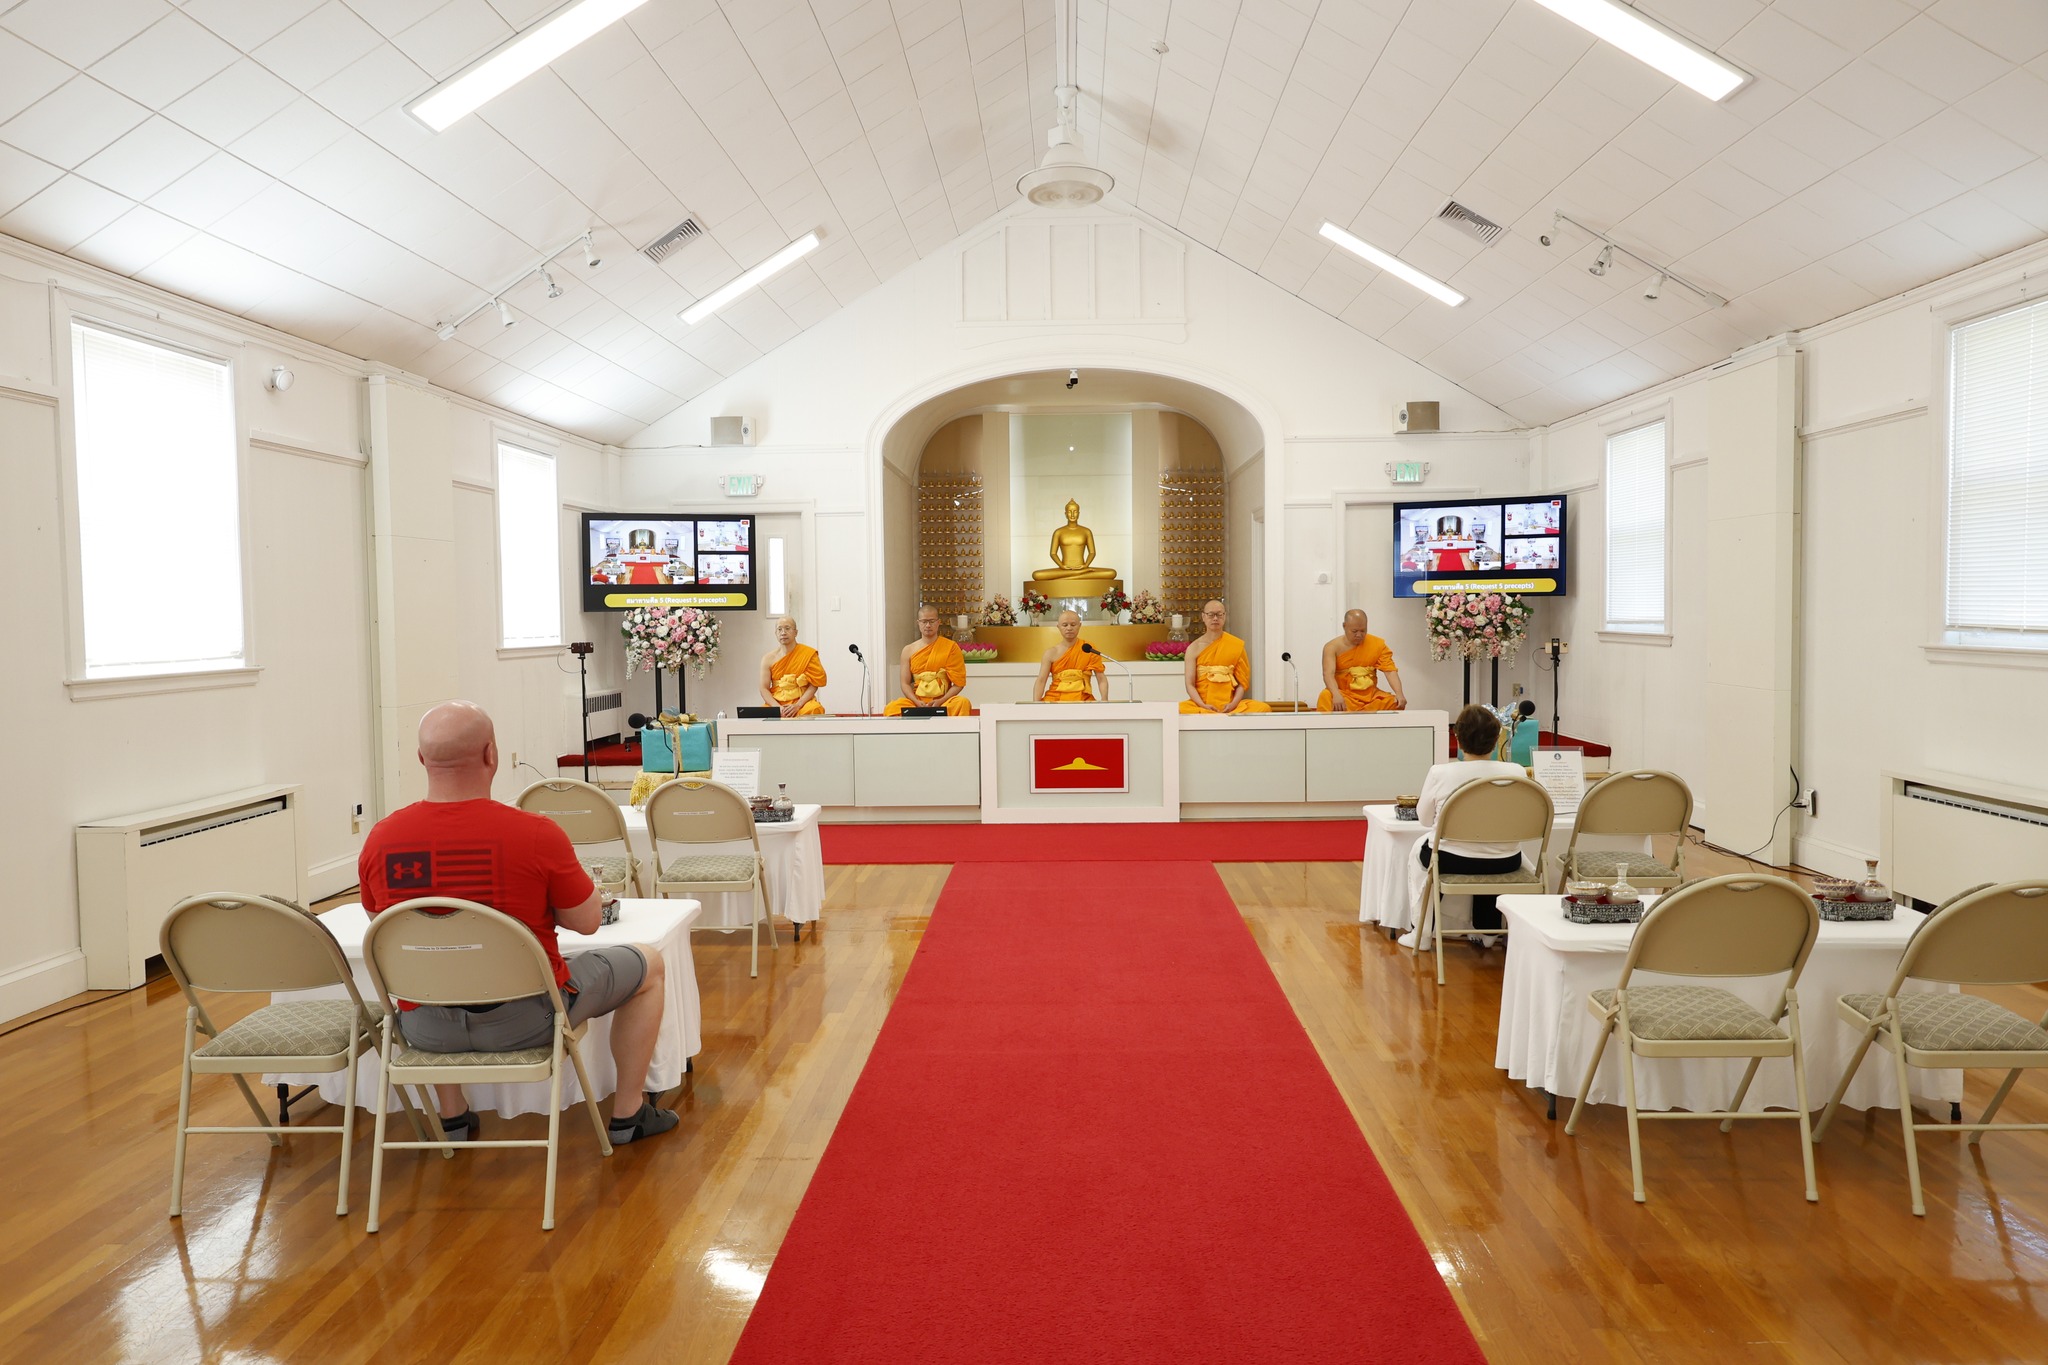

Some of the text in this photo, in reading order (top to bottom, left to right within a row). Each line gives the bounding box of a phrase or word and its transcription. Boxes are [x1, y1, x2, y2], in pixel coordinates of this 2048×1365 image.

[1397, 463, 1420, 482] EXIT
[729, 476, 753, 495] EXIT
[698, 596, 727, 604] precepts)
